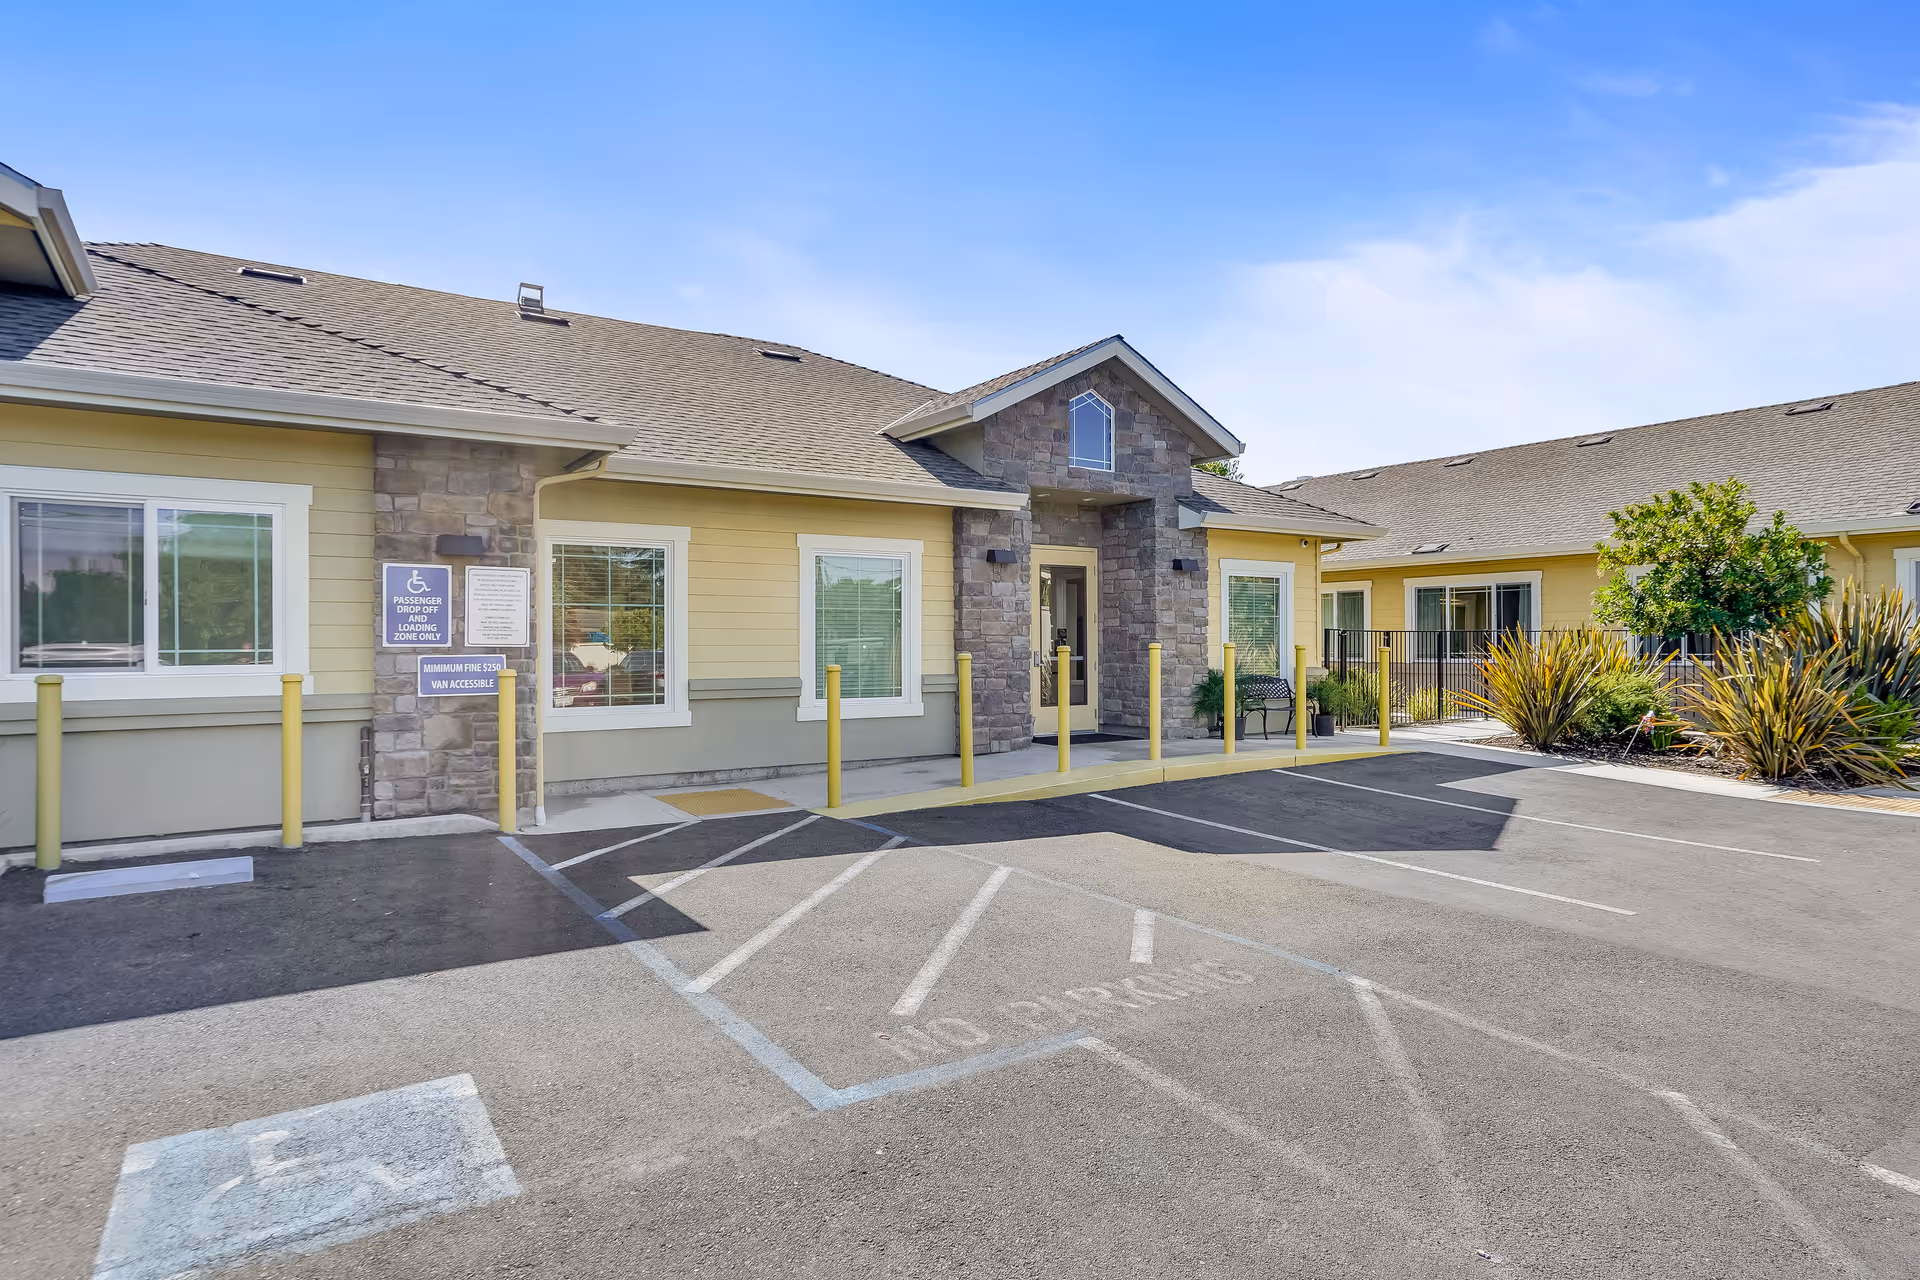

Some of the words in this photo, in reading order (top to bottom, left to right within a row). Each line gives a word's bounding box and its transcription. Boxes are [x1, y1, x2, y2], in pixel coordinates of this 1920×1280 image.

[393, 596, 442, 605] PASSENGER
[397, 605, 421, 614] DROP
[422, 605, 439, 614] OFF
[408, 614, 428, 623] AND
[398, 623, 437, 632] LOADING
[393, 632, 418, 641] ZONE
[419, 632, 442, 641] ONLY
[464, 663, 482, 673] FINE
[482, 662, 501, 673] $250
[431, 680, 448, 689] VAN
[449, 678, 494, 689] ACCESSIBLE
[872, 1017, 991, 1061] NO
[995, 959, 1255, 1032] PARKING
